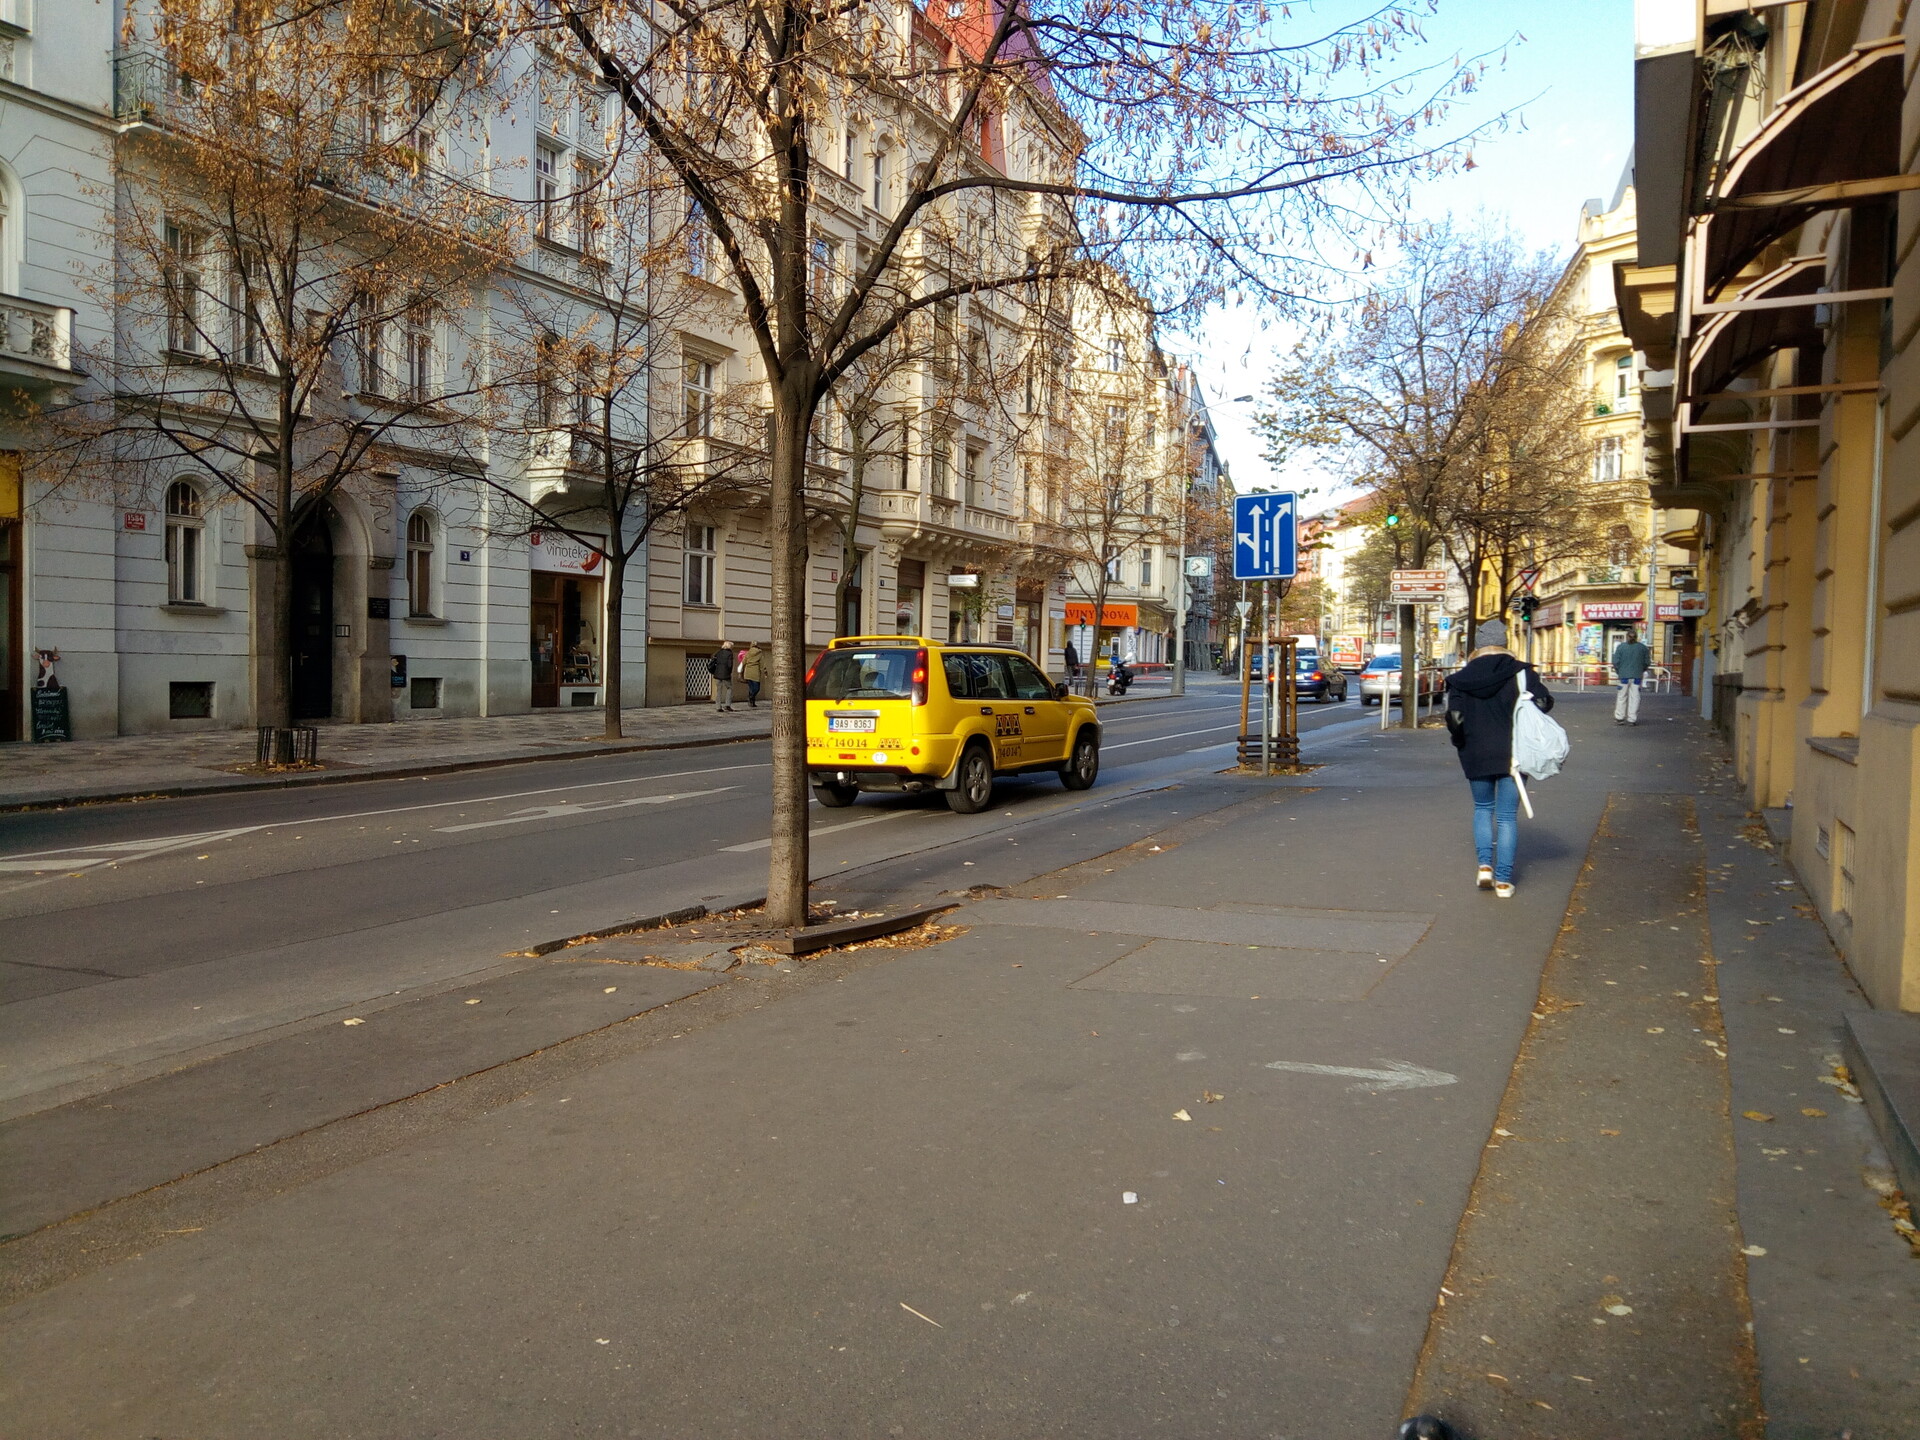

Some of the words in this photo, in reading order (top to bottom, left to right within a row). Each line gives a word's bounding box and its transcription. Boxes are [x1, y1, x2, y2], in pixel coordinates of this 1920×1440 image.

[546, 543, 589, 560] vinotéka
[1584, 603, 1642, 611] POTRAVINY
[834, 719, 849, 729] 9A9
[853, 719, 872, 729] 8363
[875, 753, 884, 762] CZ
